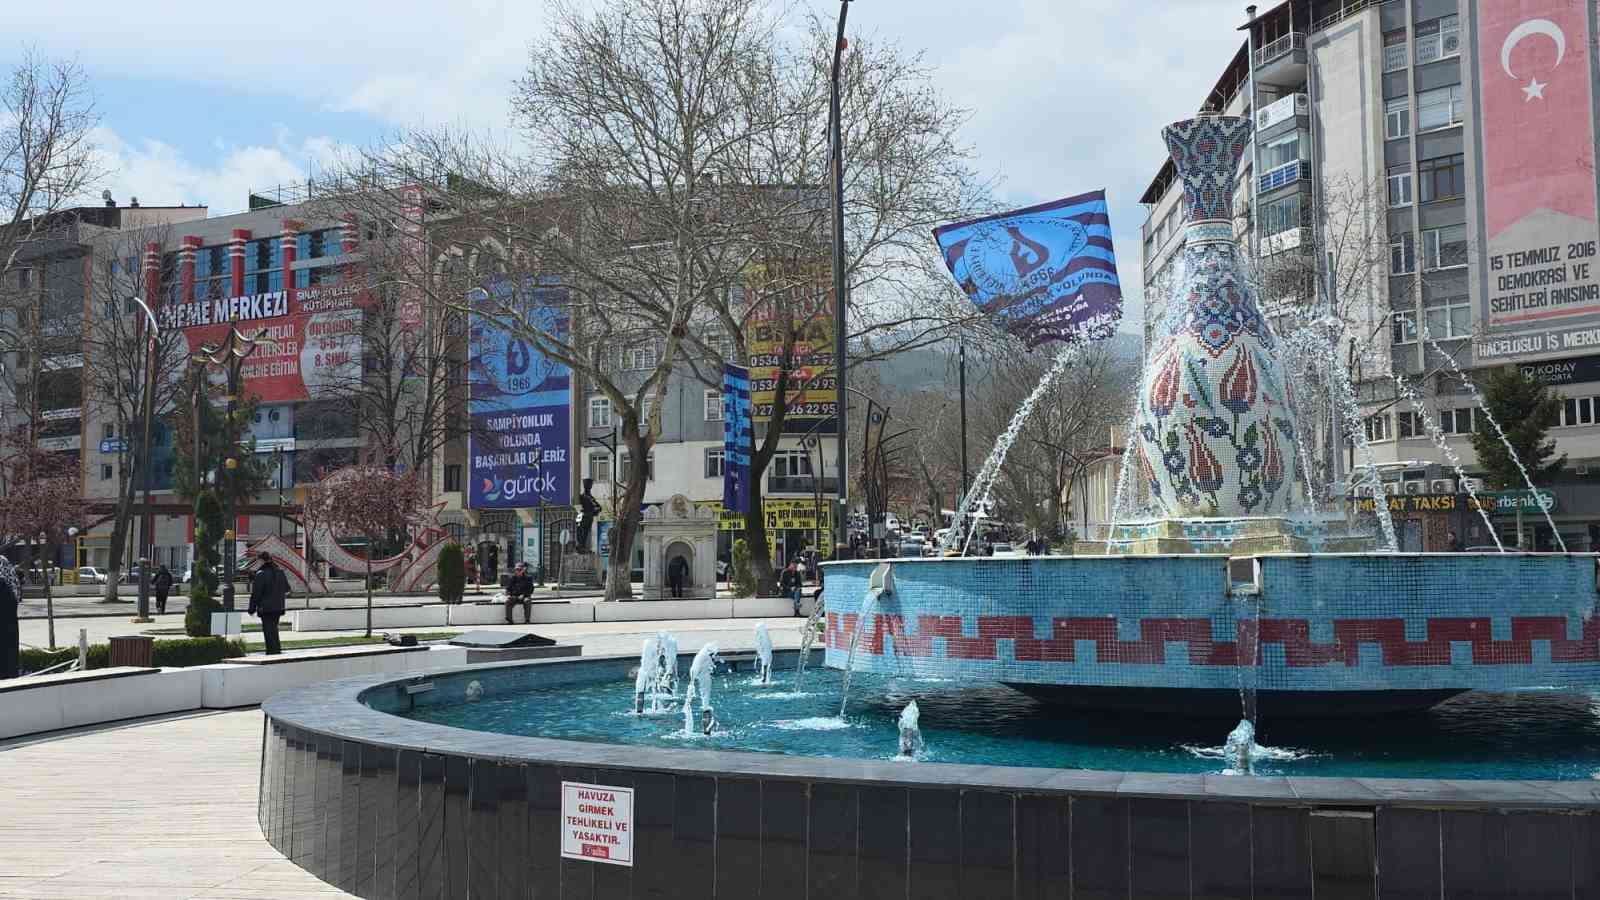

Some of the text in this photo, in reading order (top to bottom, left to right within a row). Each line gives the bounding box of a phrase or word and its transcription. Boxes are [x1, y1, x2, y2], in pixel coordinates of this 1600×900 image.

[1489, 241, 1597, 271] 15 TEMMUZ 2016
[1498, 263, 1590, 291] DEMOKRASİ VE
[1551, 284, 1600, 305] ANISINA
[214, 289, 288, 323] MERKEZİ
[1537, 362, 1577, 375] KORAY
[503, 472, 557, 500] gürok
[1357, 496, 1406, 510] MUAT
[1413, 496, 1455, 510] TAKSİ
[766, 512, 777, 528] 75
[578, 790, 616, 803] HAVUZA
[615, 822, 628, 832] VE
[573, 830, 621, 846] YASAKTIR.
